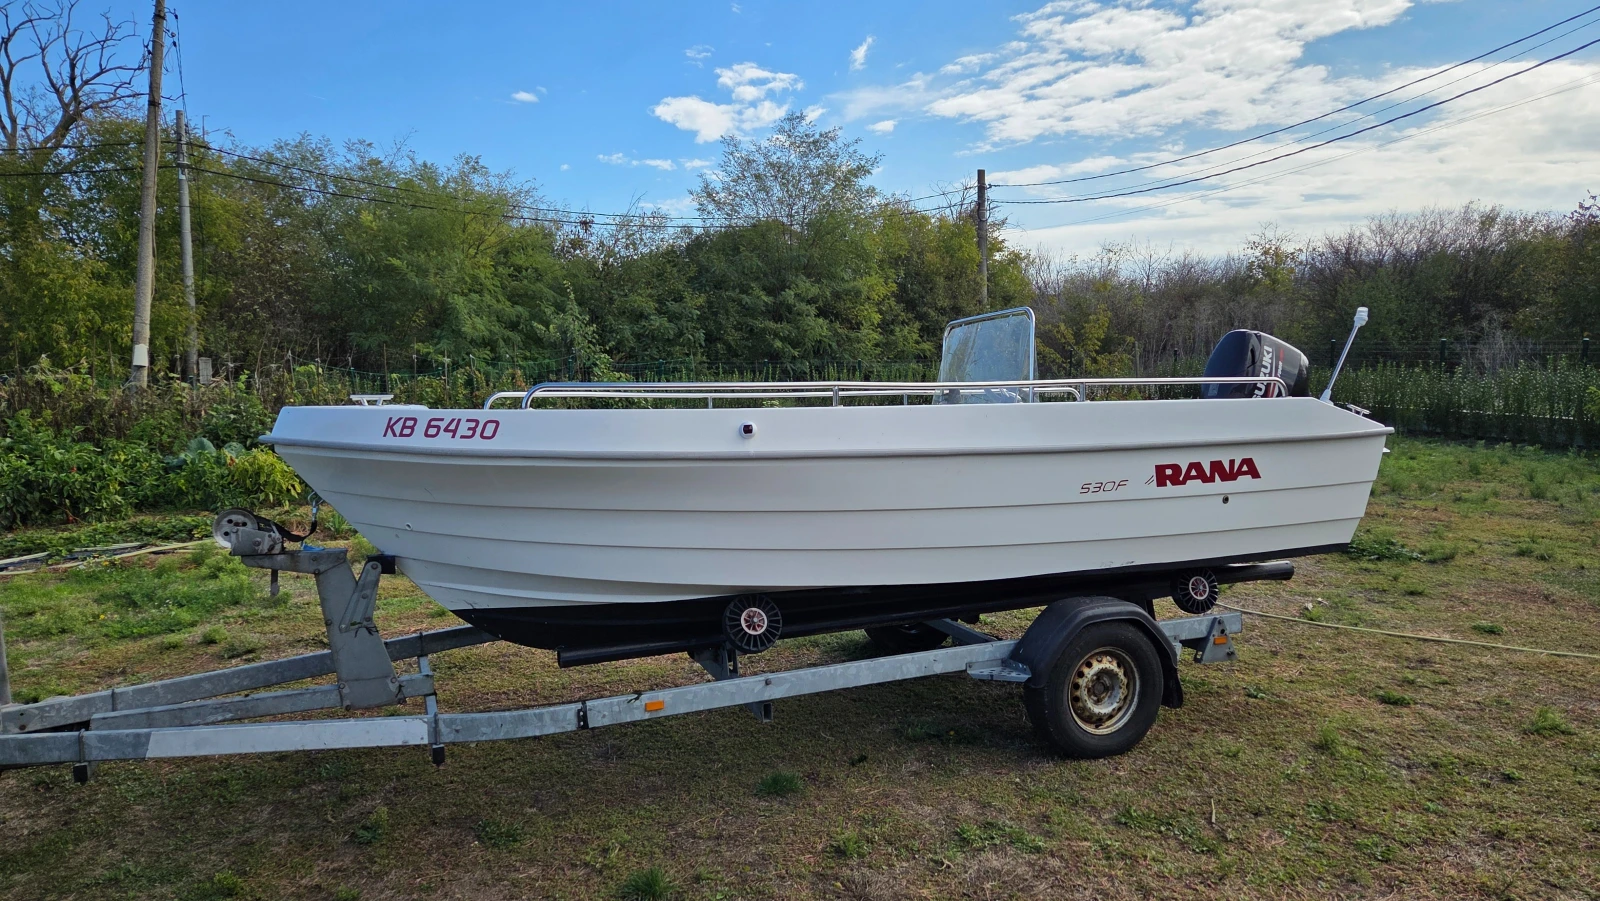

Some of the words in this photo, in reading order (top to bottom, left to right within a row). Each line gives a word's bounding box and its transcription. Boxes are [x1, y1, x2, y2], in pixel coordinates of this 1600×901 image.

[382, 416, 418, 438] KB
[423, 417, 501, 440] 6430
[1154, 457, 1262, 487] RANA
